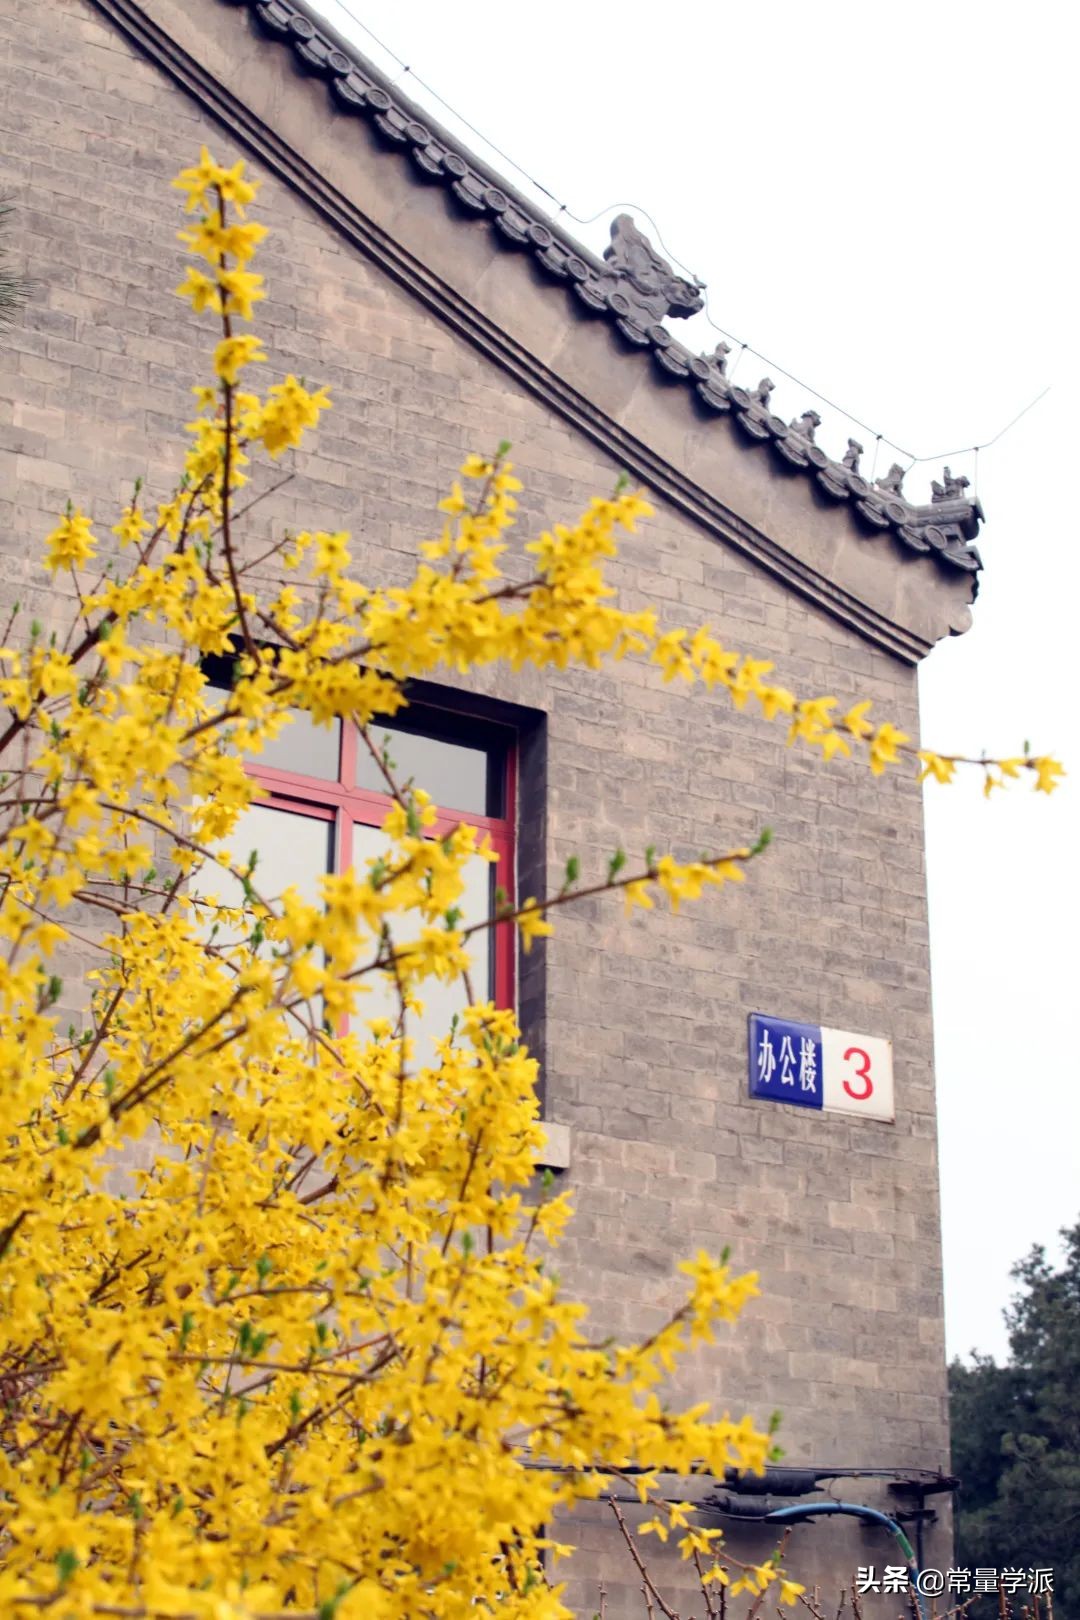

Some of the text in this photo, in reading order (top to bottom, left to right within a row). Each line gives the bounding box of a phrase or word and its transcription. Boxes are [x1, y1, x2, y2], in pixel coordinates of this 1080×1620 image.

[757, 1028, 874, 1101] 办公楼 3
